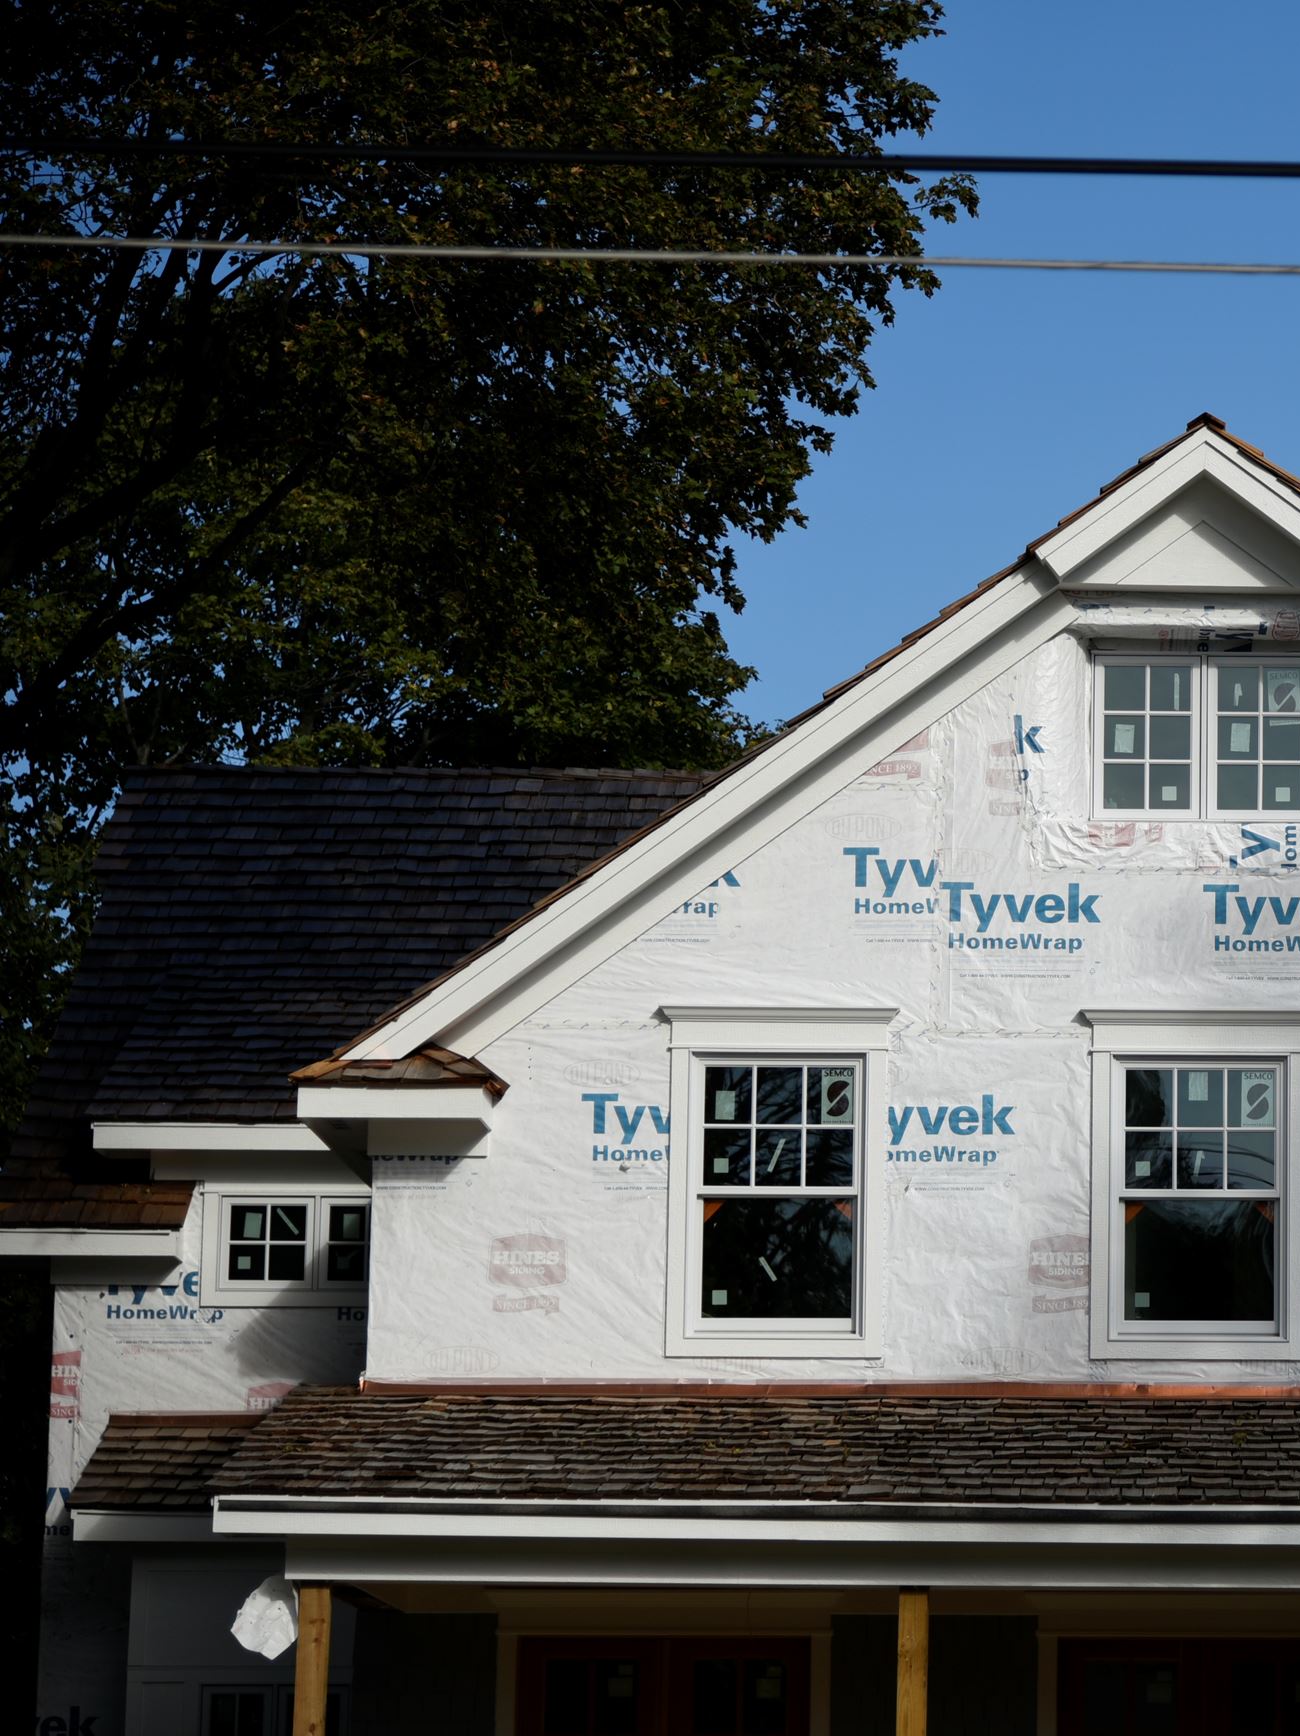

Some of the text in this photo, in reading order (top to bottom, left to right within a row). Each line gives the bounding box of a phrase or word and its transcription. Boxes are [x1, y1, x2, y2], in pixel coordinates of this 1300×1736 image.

[942, 882, 1100, 933] Tyvek
[949, 932, 1083, 952] HomeWrap
[1244, 1073, 1273, 1081] SEMCO
[1031, 1252, 1088, 1266] HINE
[1048, 1267, 1084, 1276] SIDING
[1035, 1301, 1069, 1312] SINCE
[107, 1305, 224, 1324] HomeWrp
